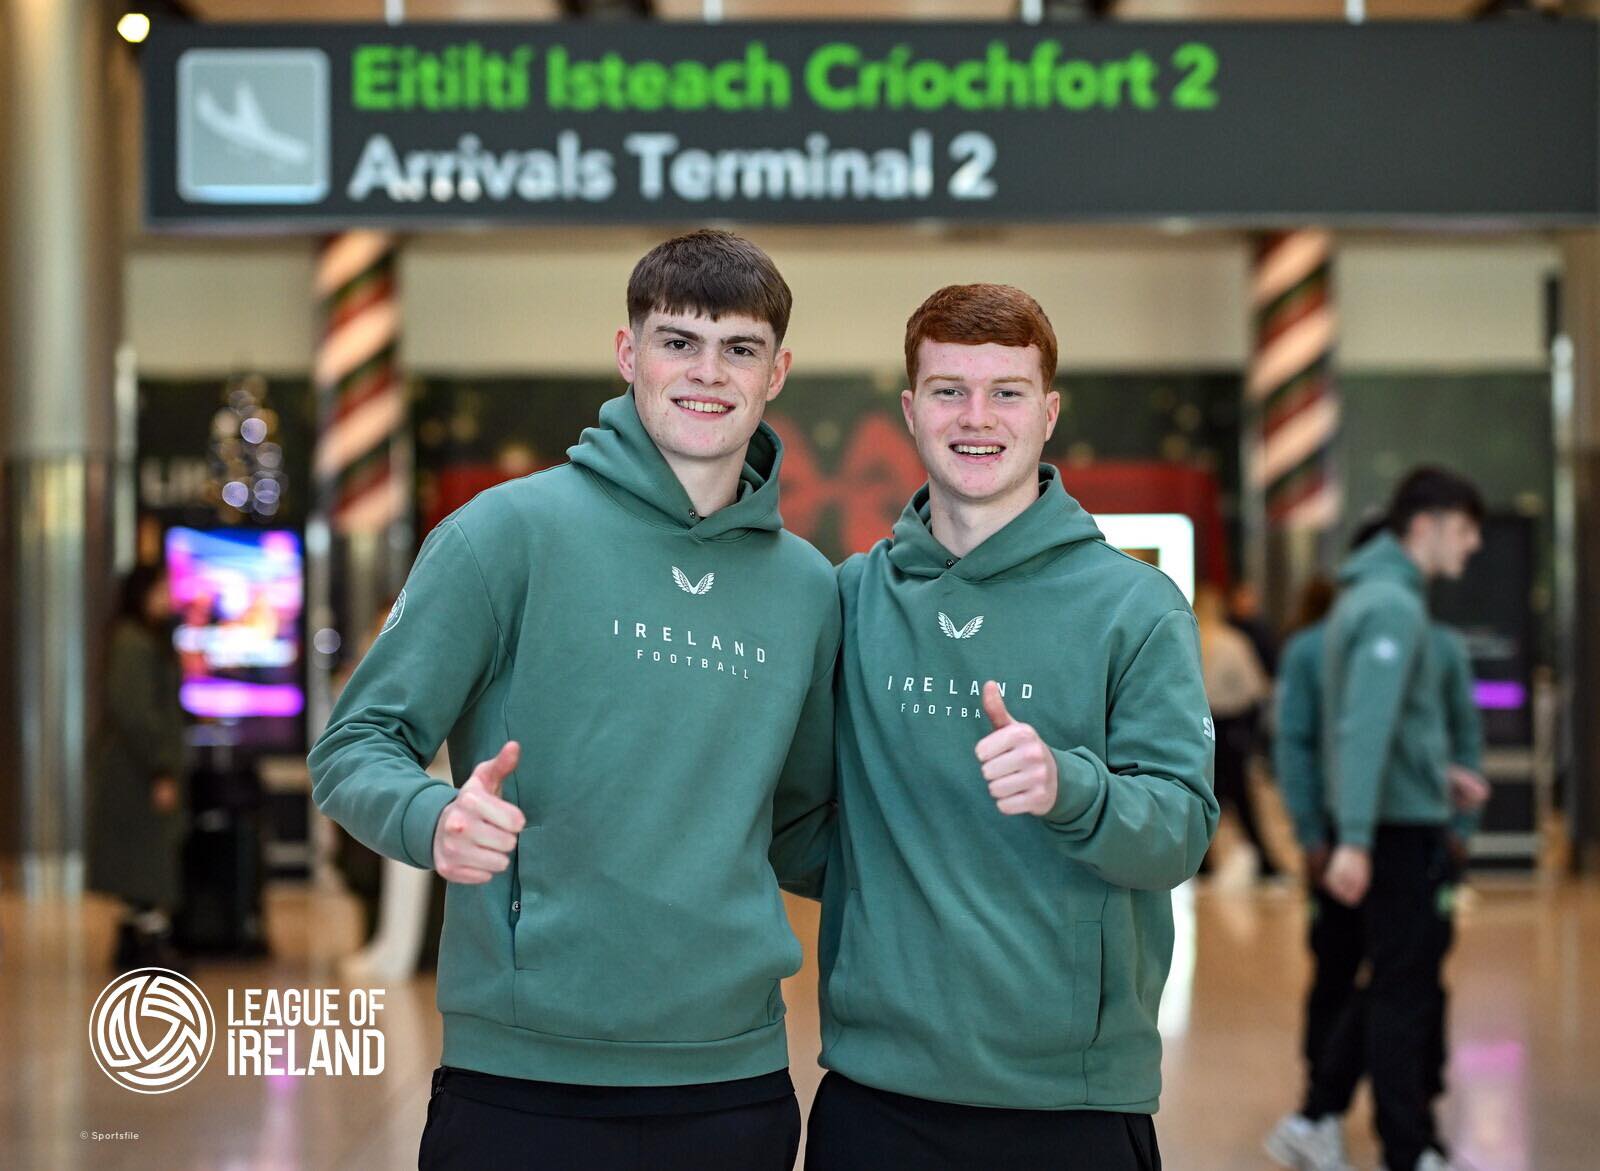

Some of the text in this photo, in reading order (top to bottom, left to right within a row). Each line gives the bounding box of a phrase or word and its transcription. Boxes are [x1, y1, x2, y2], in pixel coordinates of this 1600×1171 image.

[351, 40, 1219, 111] Eitiltí Isteach Críochfort 2
[347, 130, 998, 202] Arrivals Terminal 2
[614, 619, 766, 663] IRELAND
[636, 649, 749, 680] FOOTBALL
[887, 675, 1033, 700] IRELAND
[901, 703, 981, 719] FOOTBA
